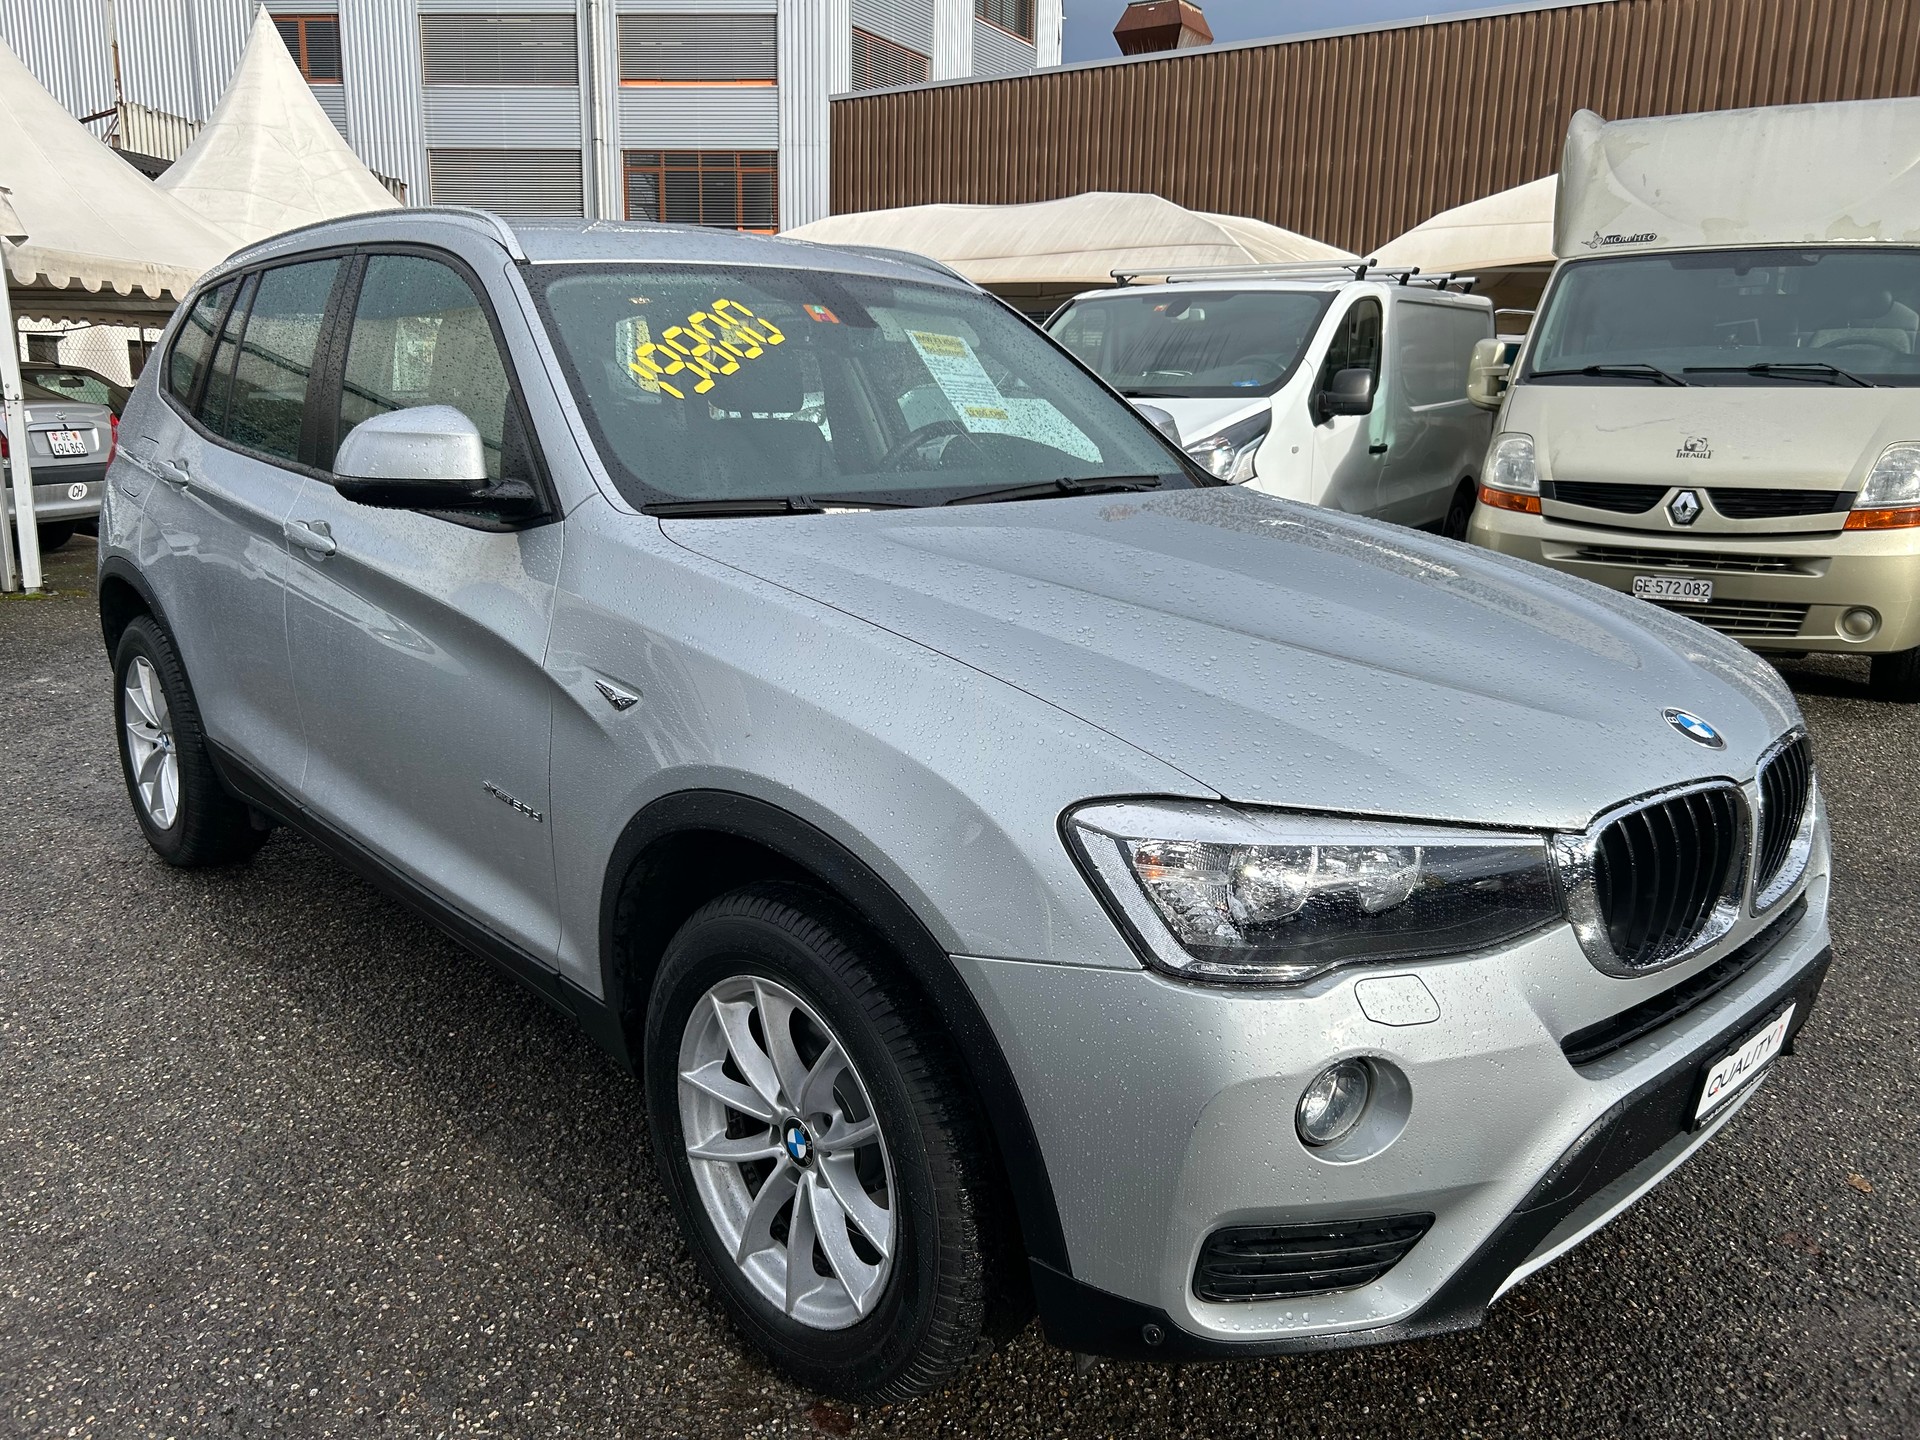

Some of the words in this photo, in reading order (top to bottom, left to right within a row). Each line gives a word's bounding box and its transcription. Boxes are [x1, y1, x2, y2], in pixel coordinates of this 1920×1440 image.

[629, 298, 786, 399] 19800
[60, 432, 70, 441] GE
[72, 485, 84, 498] CH
